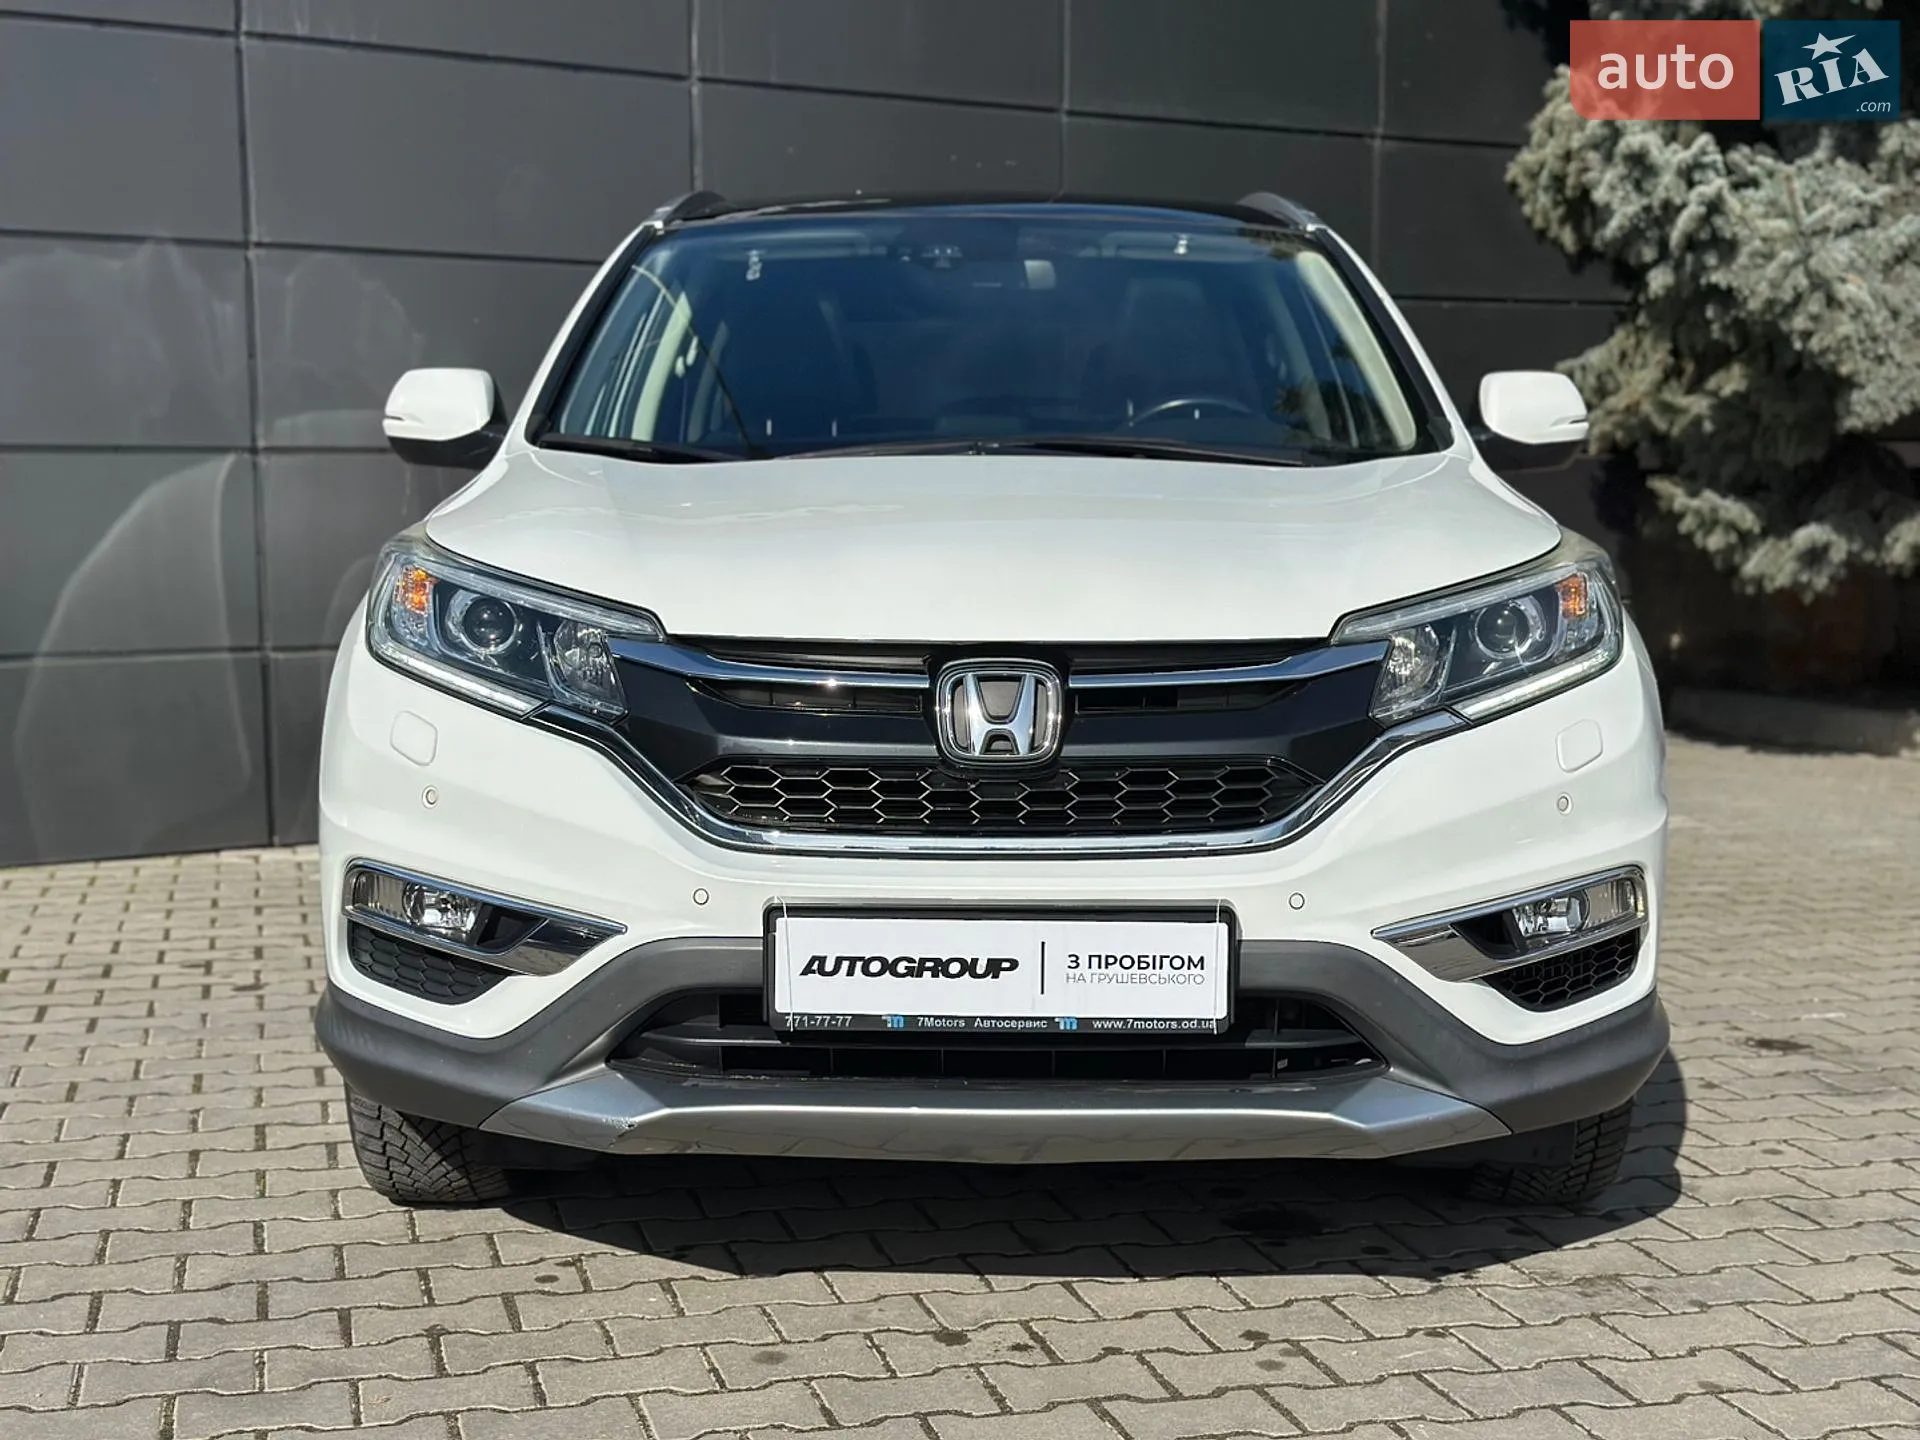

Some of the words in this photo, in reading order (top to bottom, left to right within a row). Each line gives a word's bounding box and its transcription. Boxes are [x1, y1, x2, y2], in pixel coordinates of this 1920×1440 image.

[799, 955, 1020, 979] AUTOGROUP
[1087, 954, 1205, 970] ПРОБІГОМ
[1065, 973, 1087, 984] НА
[1090, 973, 1206, 985] ГРУШЕВСЬКОГО
[785, 1015, 852, 1028] 771-77-77
[917, 1017, 966, 1028] 7Motors
[973, 1017, 1048, 1030] Автосервис
[1092, 1019, 1216, 1030] www.7motors.od.ua
